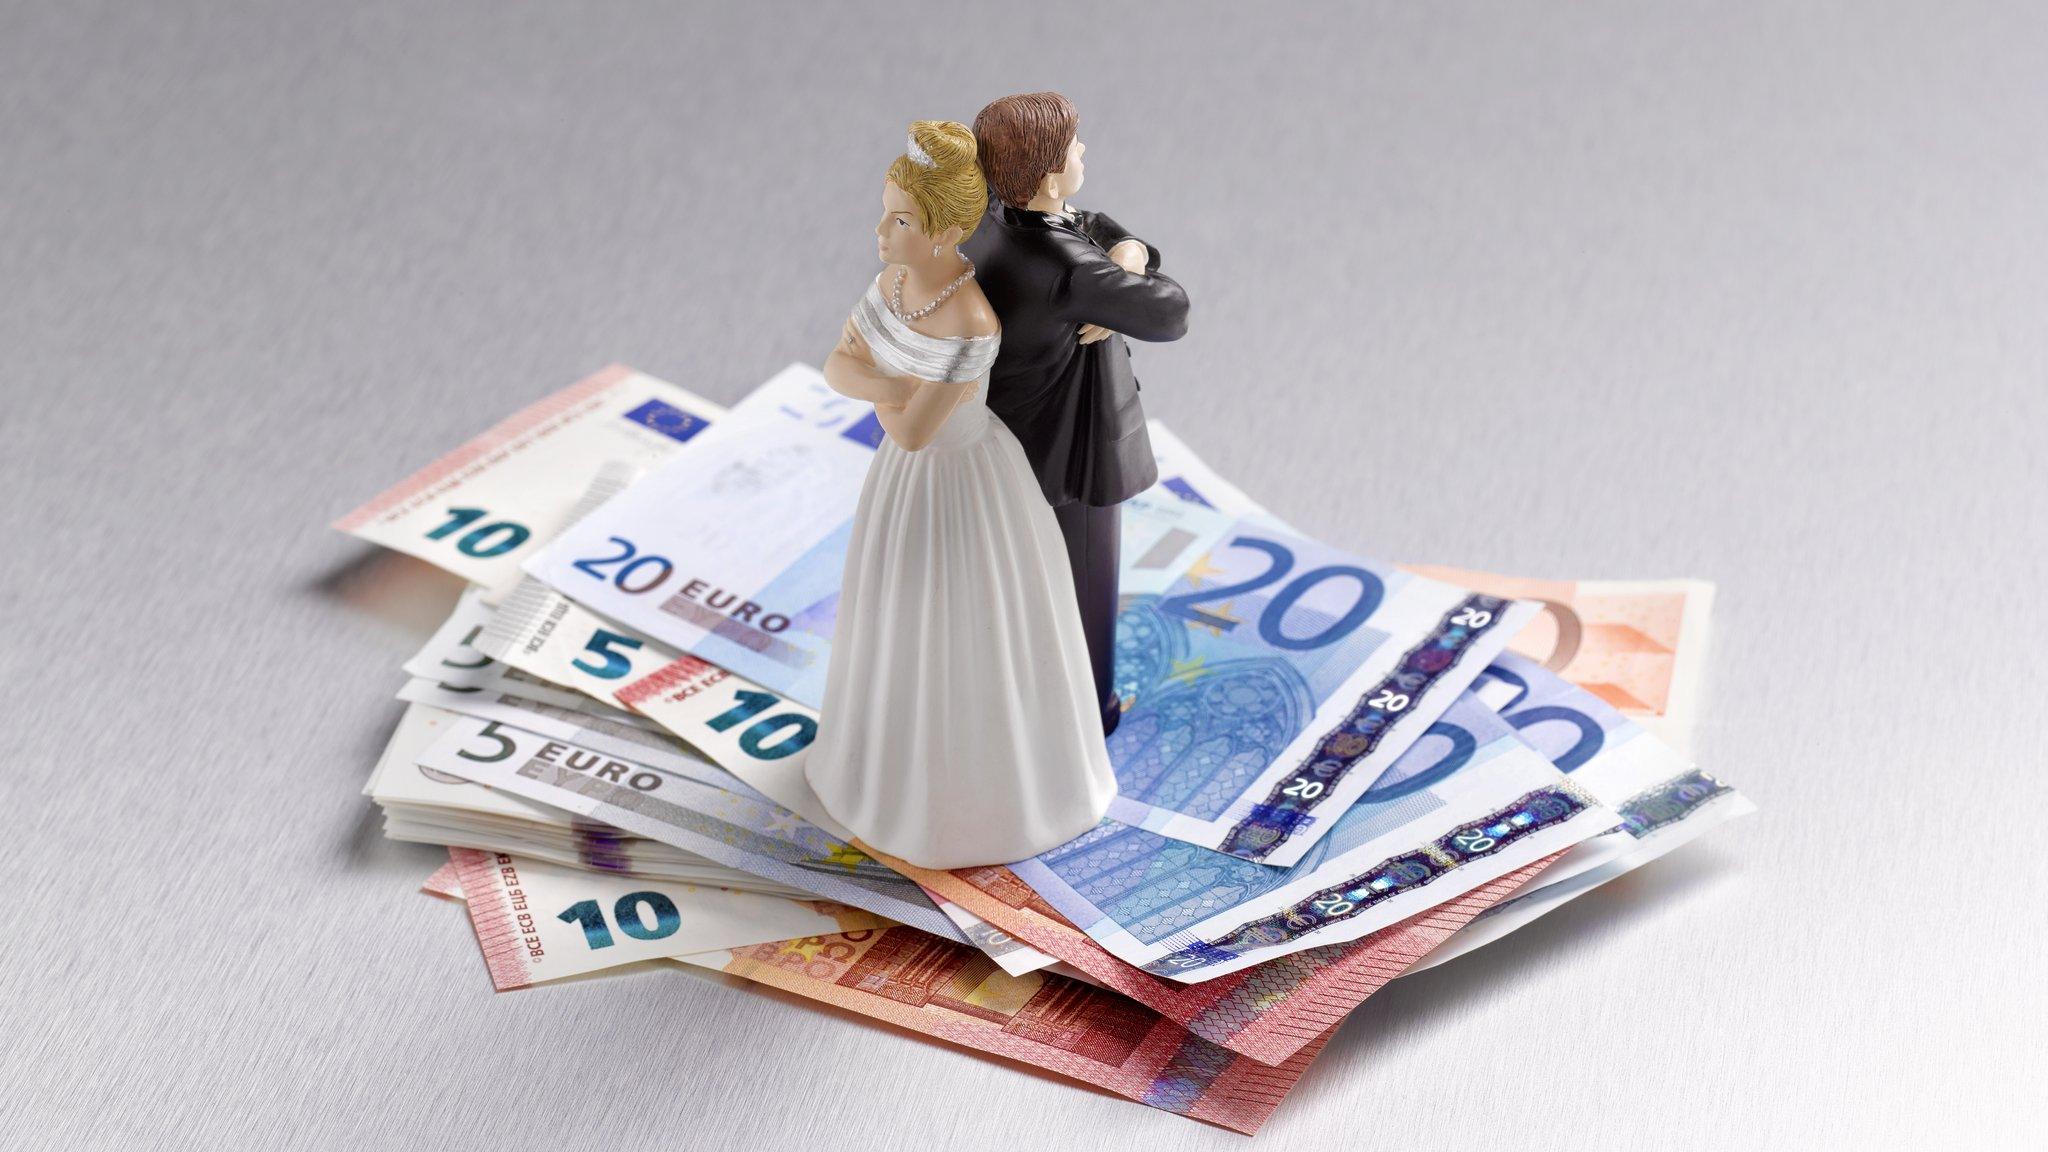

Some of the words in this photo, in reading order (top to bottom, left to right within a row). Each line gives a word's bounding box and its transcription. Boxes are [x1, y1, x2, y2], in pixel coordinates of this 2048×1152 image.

[424, 507, 532, 558] 10
[572, 536, 674, 595] 20
[679, 578, 792, 633] EURO
[1155, 536, 1386, 651] 20
[1450, 606, 1492, 629] 20
[571, 628, 644, 680] 5
[1368, 689, 1410, 712] 20
[705, 689, 819, 760] 10
[456, 720, 517, 763] 5
[534, 741, 663, 791] EURO
[1283, 778, 1324, 799] 20
[1454, 828, 1496, 853] 20
[501, 865, 519, 887] EZB
[1314, 893, 1353, 916] 20
[517, 913, 536, 935] ECB
[556, 890, 682, 950] 10
[1168, 953, 1207, 969] 20
